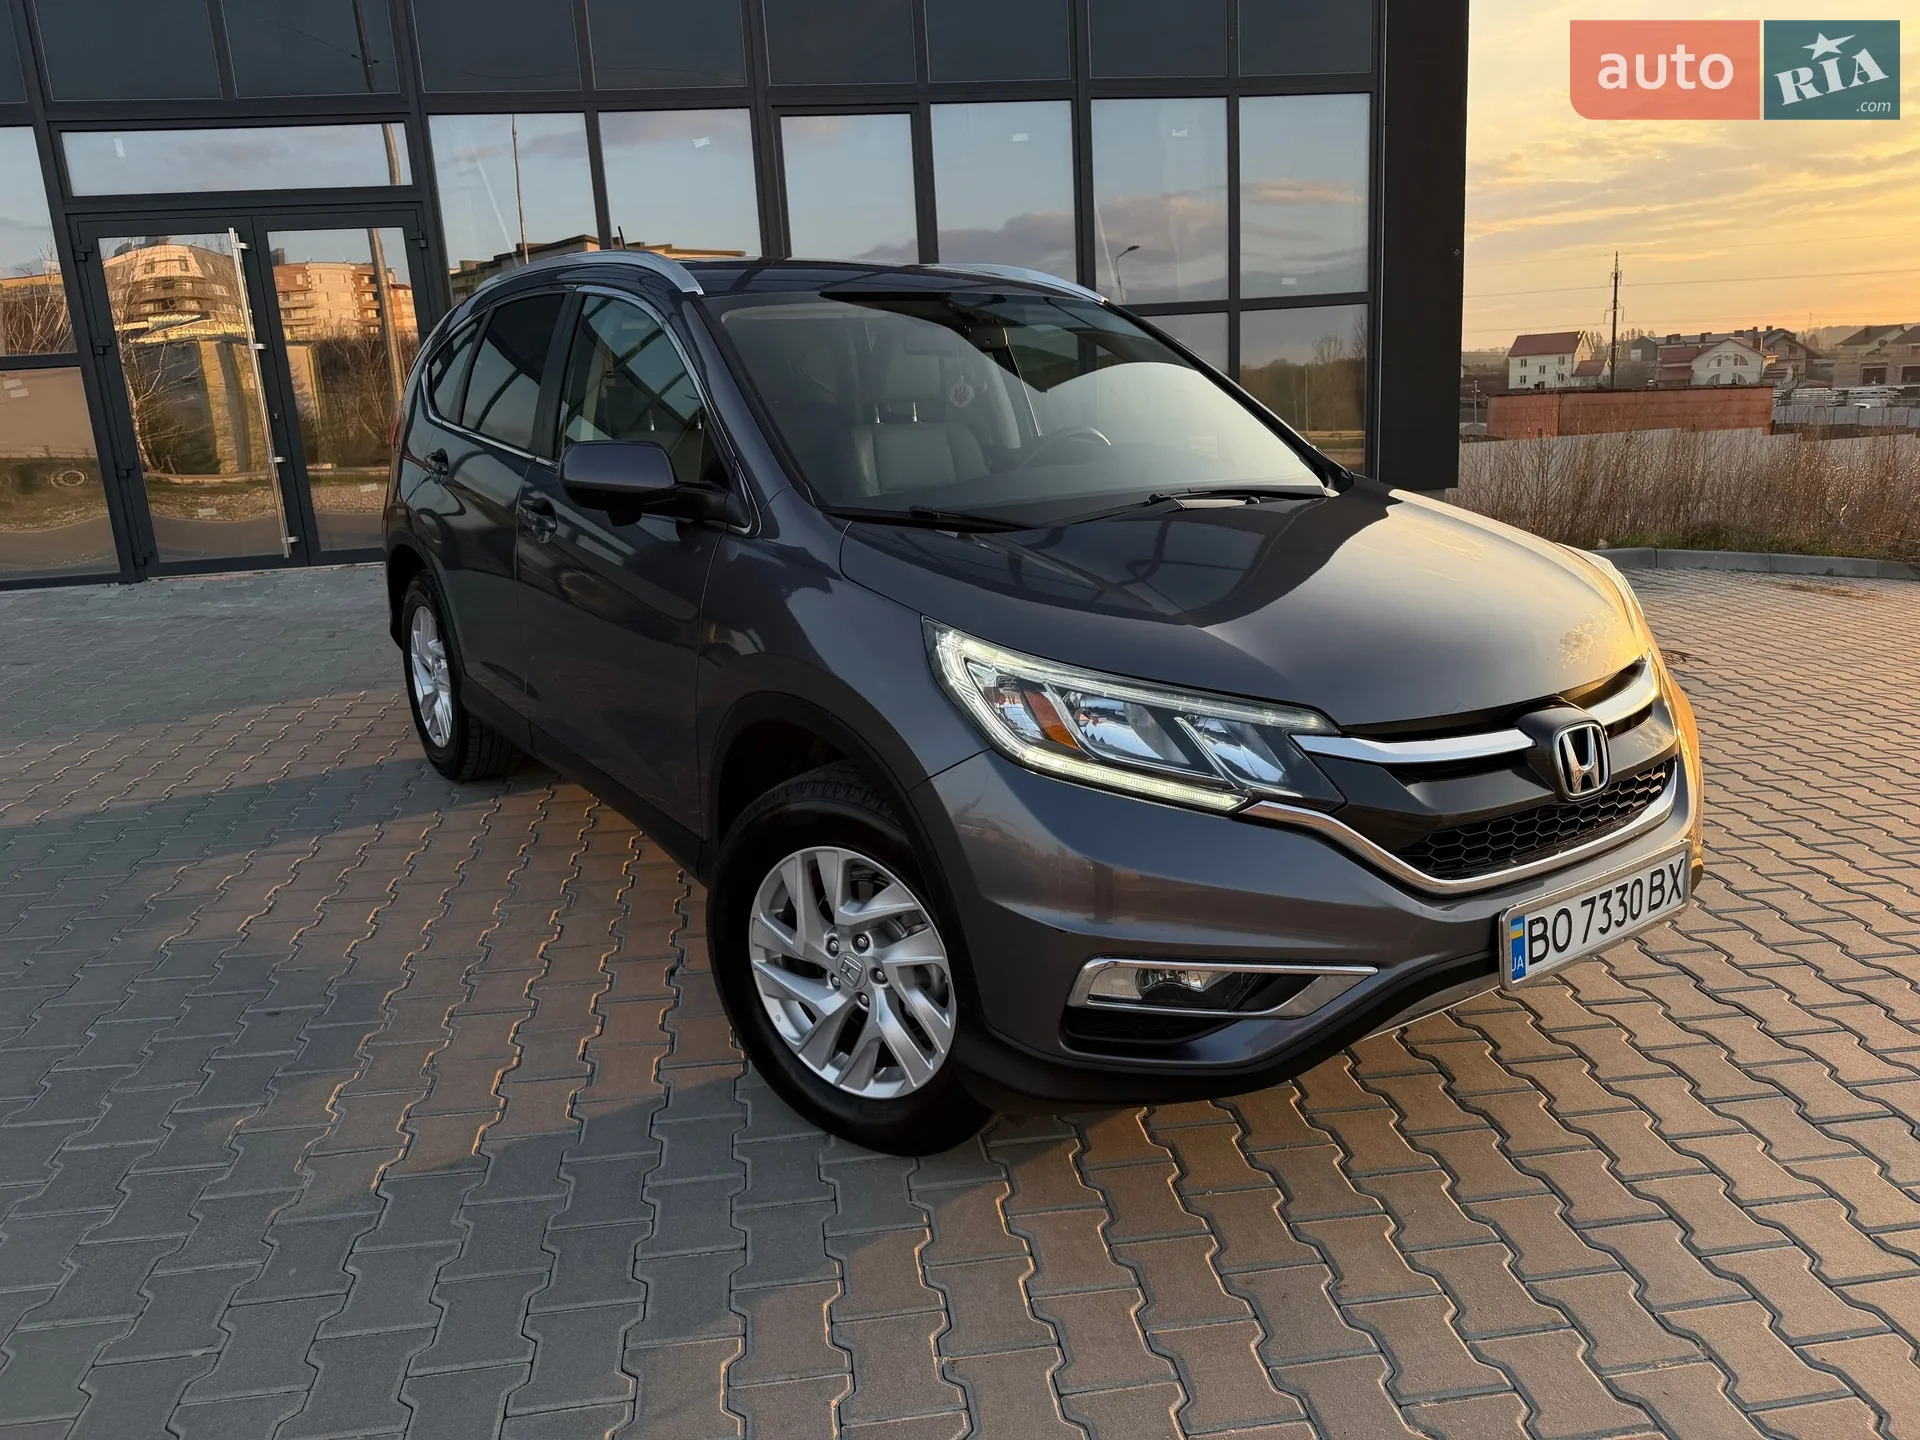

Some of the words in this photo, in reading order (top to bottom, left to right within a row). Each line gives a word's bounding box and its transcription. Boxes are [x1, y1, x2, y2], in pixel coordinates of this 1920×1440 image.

[1527, 907, 1573, 966] BO
[1580, 877, 1643, 944] 7330
[1648, 857, 1684, 913] BX
